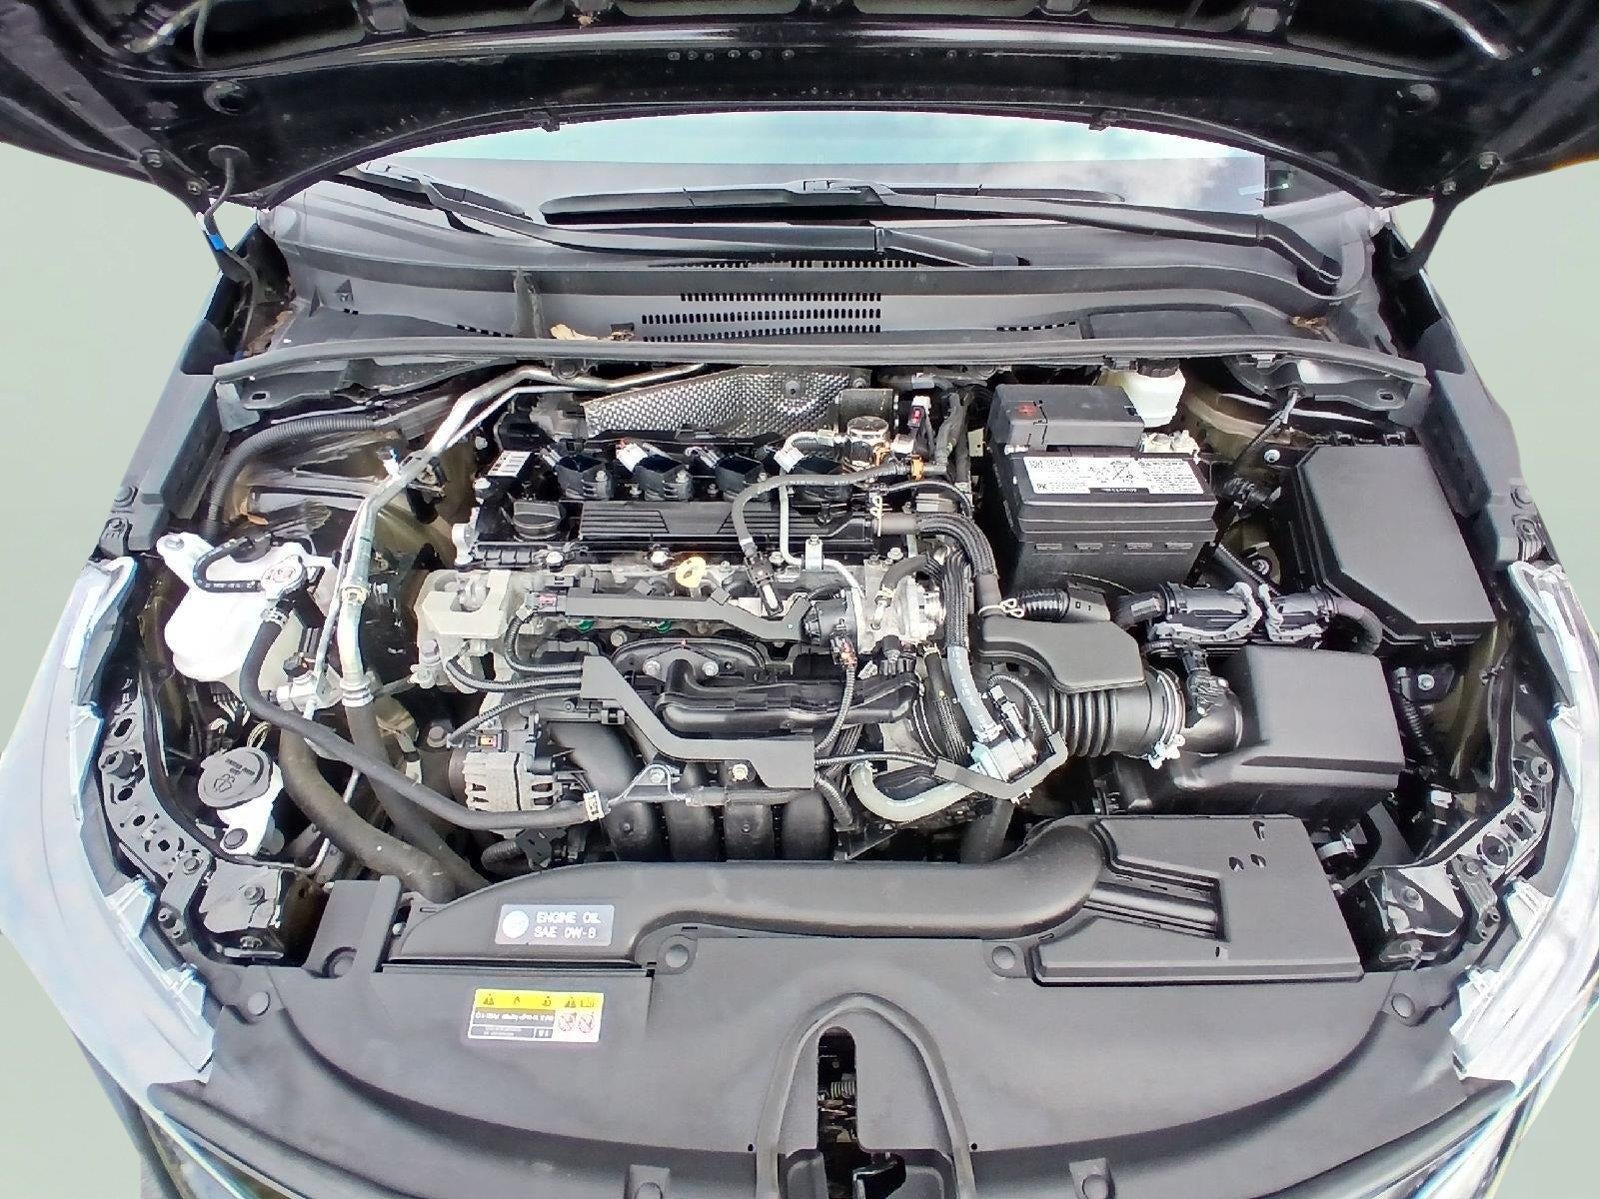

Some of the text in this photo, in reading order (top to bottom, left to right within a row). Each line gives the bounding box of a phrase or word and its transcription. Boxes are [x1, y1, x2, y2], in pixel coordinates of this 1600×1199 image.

[536, 911, 601, 924] ENGINE OIL
[534, 926, 558, 938] SAE
